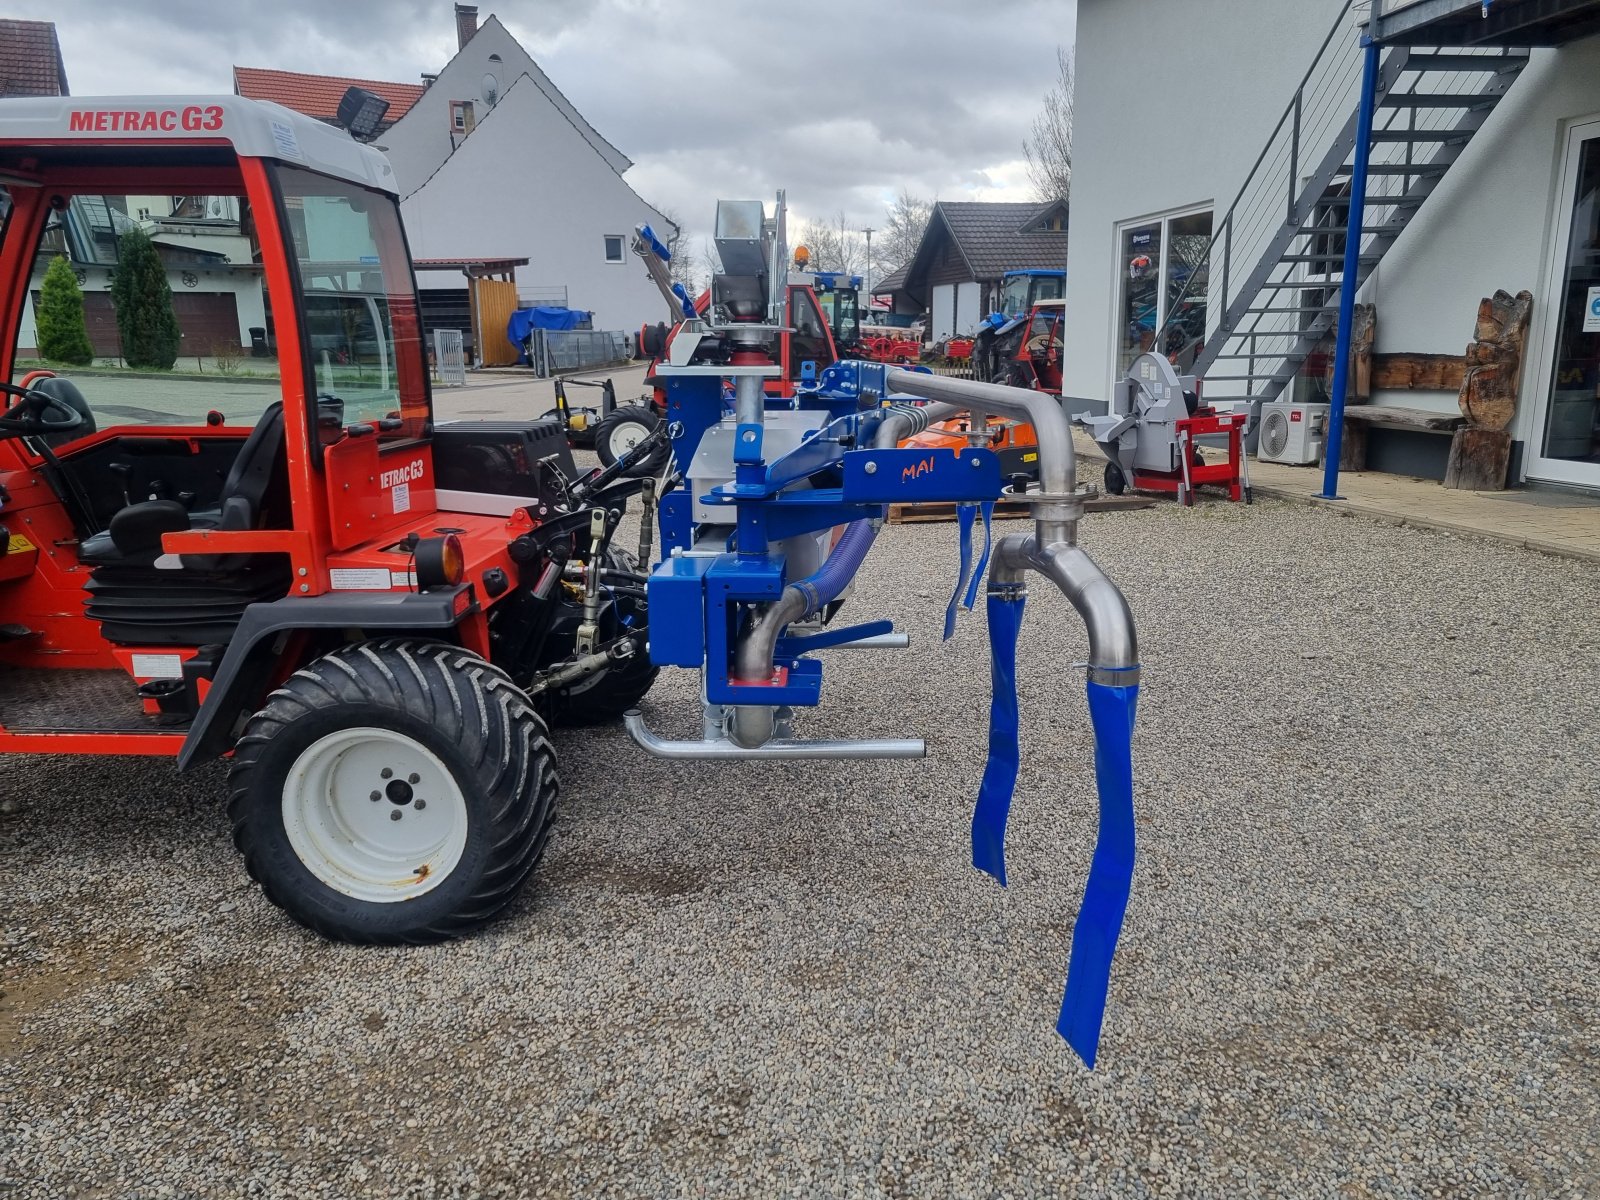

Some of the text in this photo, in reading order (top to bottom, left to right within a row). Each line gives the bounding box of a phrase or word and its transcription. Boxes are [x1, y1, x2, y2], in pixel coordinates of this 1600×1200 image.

[69, 106, 224, 132] METRAC G3
[411, 459, 424, 480] G3
[902, 456, 935, 483] MAI
